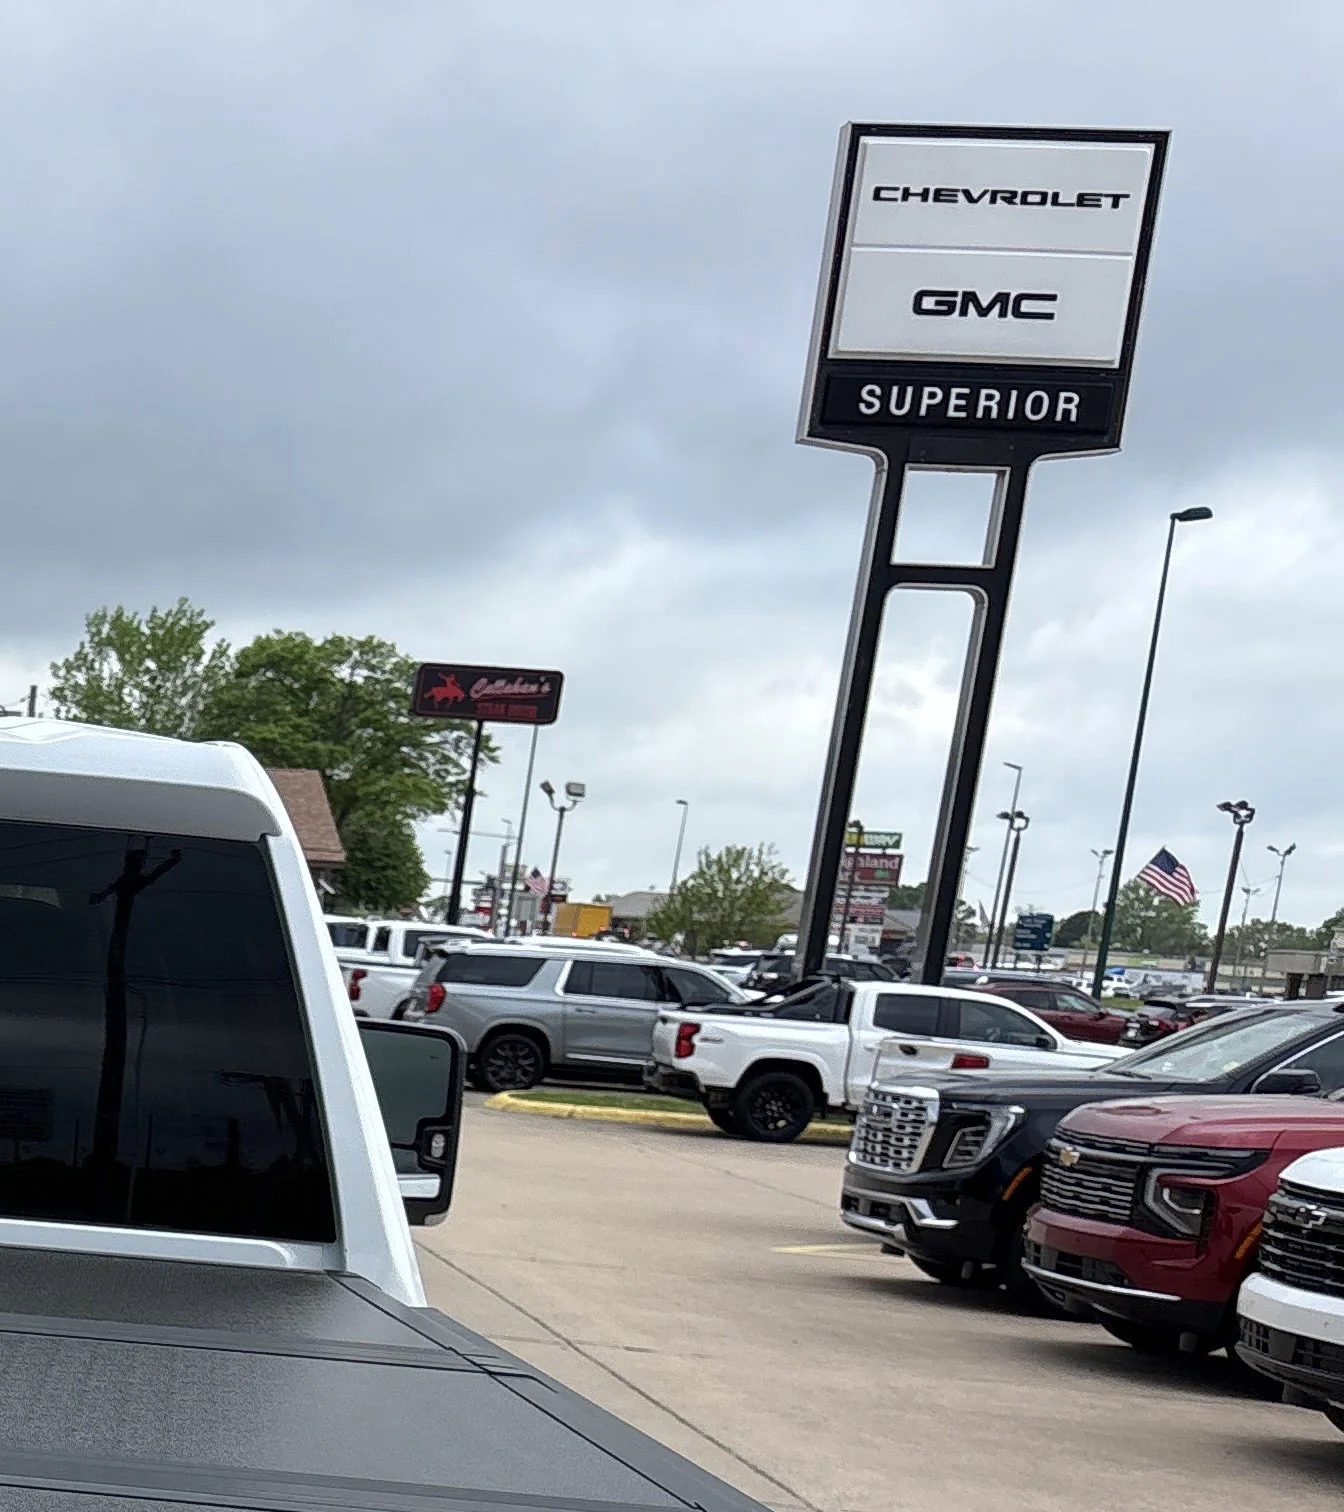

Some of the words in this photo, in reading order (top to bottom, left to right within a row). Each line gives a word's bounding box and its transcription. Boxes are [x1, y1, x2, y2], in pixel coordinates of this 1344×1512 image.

[872, 185, 1131, 210] CHEVROLET
[912, 289, 1058, 321] GMC
[858, 384, 1081, 423] SUPERIOR
